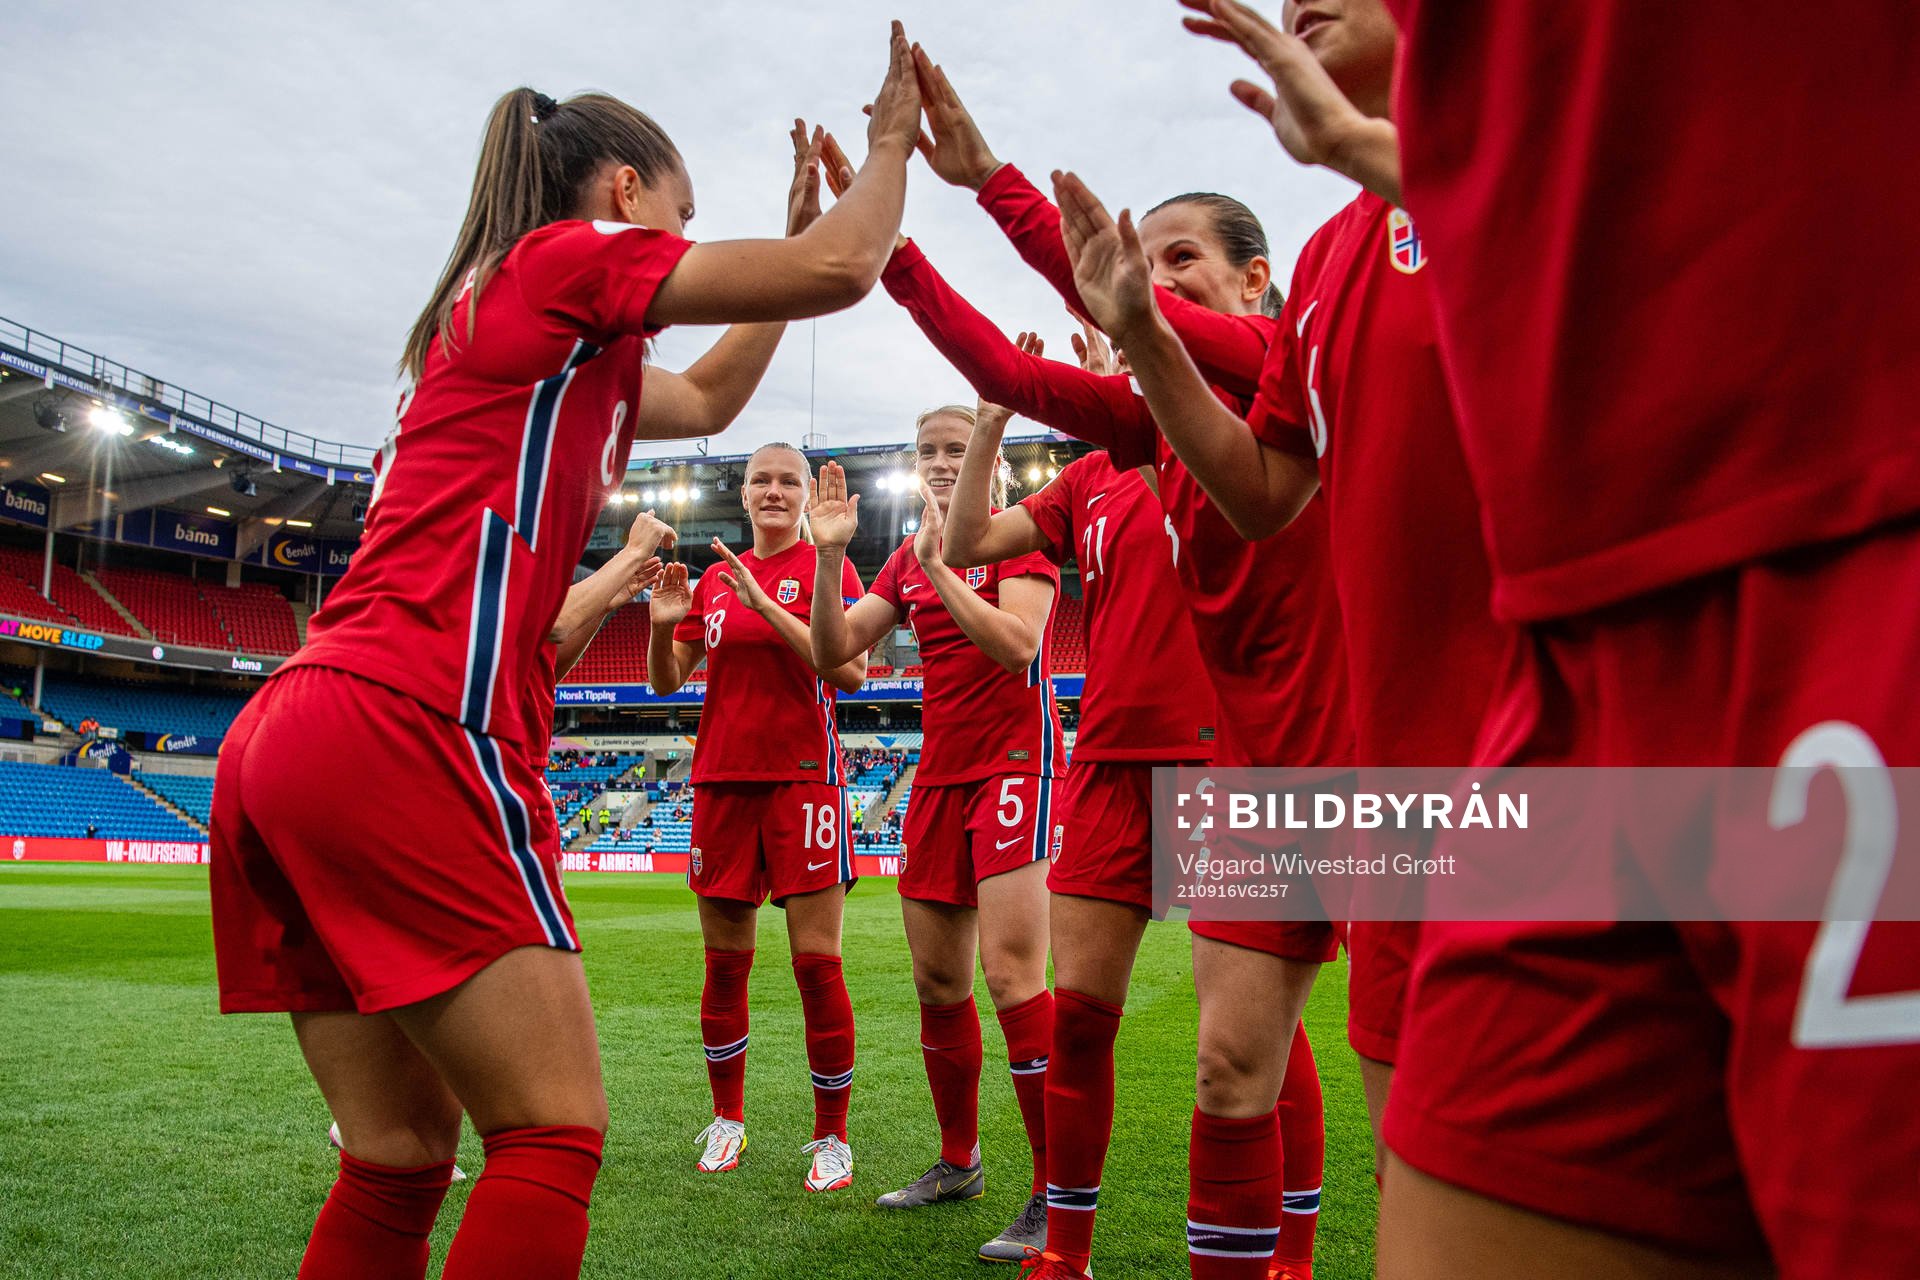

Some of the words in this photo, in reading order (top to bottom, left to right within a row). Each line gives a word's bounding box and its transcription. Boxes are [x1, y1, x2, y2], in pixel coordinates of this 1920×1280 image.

[601, 400, 628, 486] 8
[5, 489, 47, 517] bama
[174, 523, 219, 547] bama
[285, 544, 316, 559] Bendit
[328, 549, 353, 565] ba
[18, 622, 61, 644] MOVE
[62, 629, 105, 650] SLEEP
[231, 656, 262, 671] bama
[559, 690, 584, 700] Norsk
[584, 690, 616, 702] Tipping
[89, 742, 117, 759] Bendit
[166, 734, 197, 751] Bendit
[997, 778, 1025, 827] 5
[802, 803, 836, 849] 18
[106, 840, 198, 863] VM-KVALIFISERING
[598, 854, 654, 871] ARMENIA
[879, 857, 899, 875] VM
[1767, 720, 1920, 1048] 2
